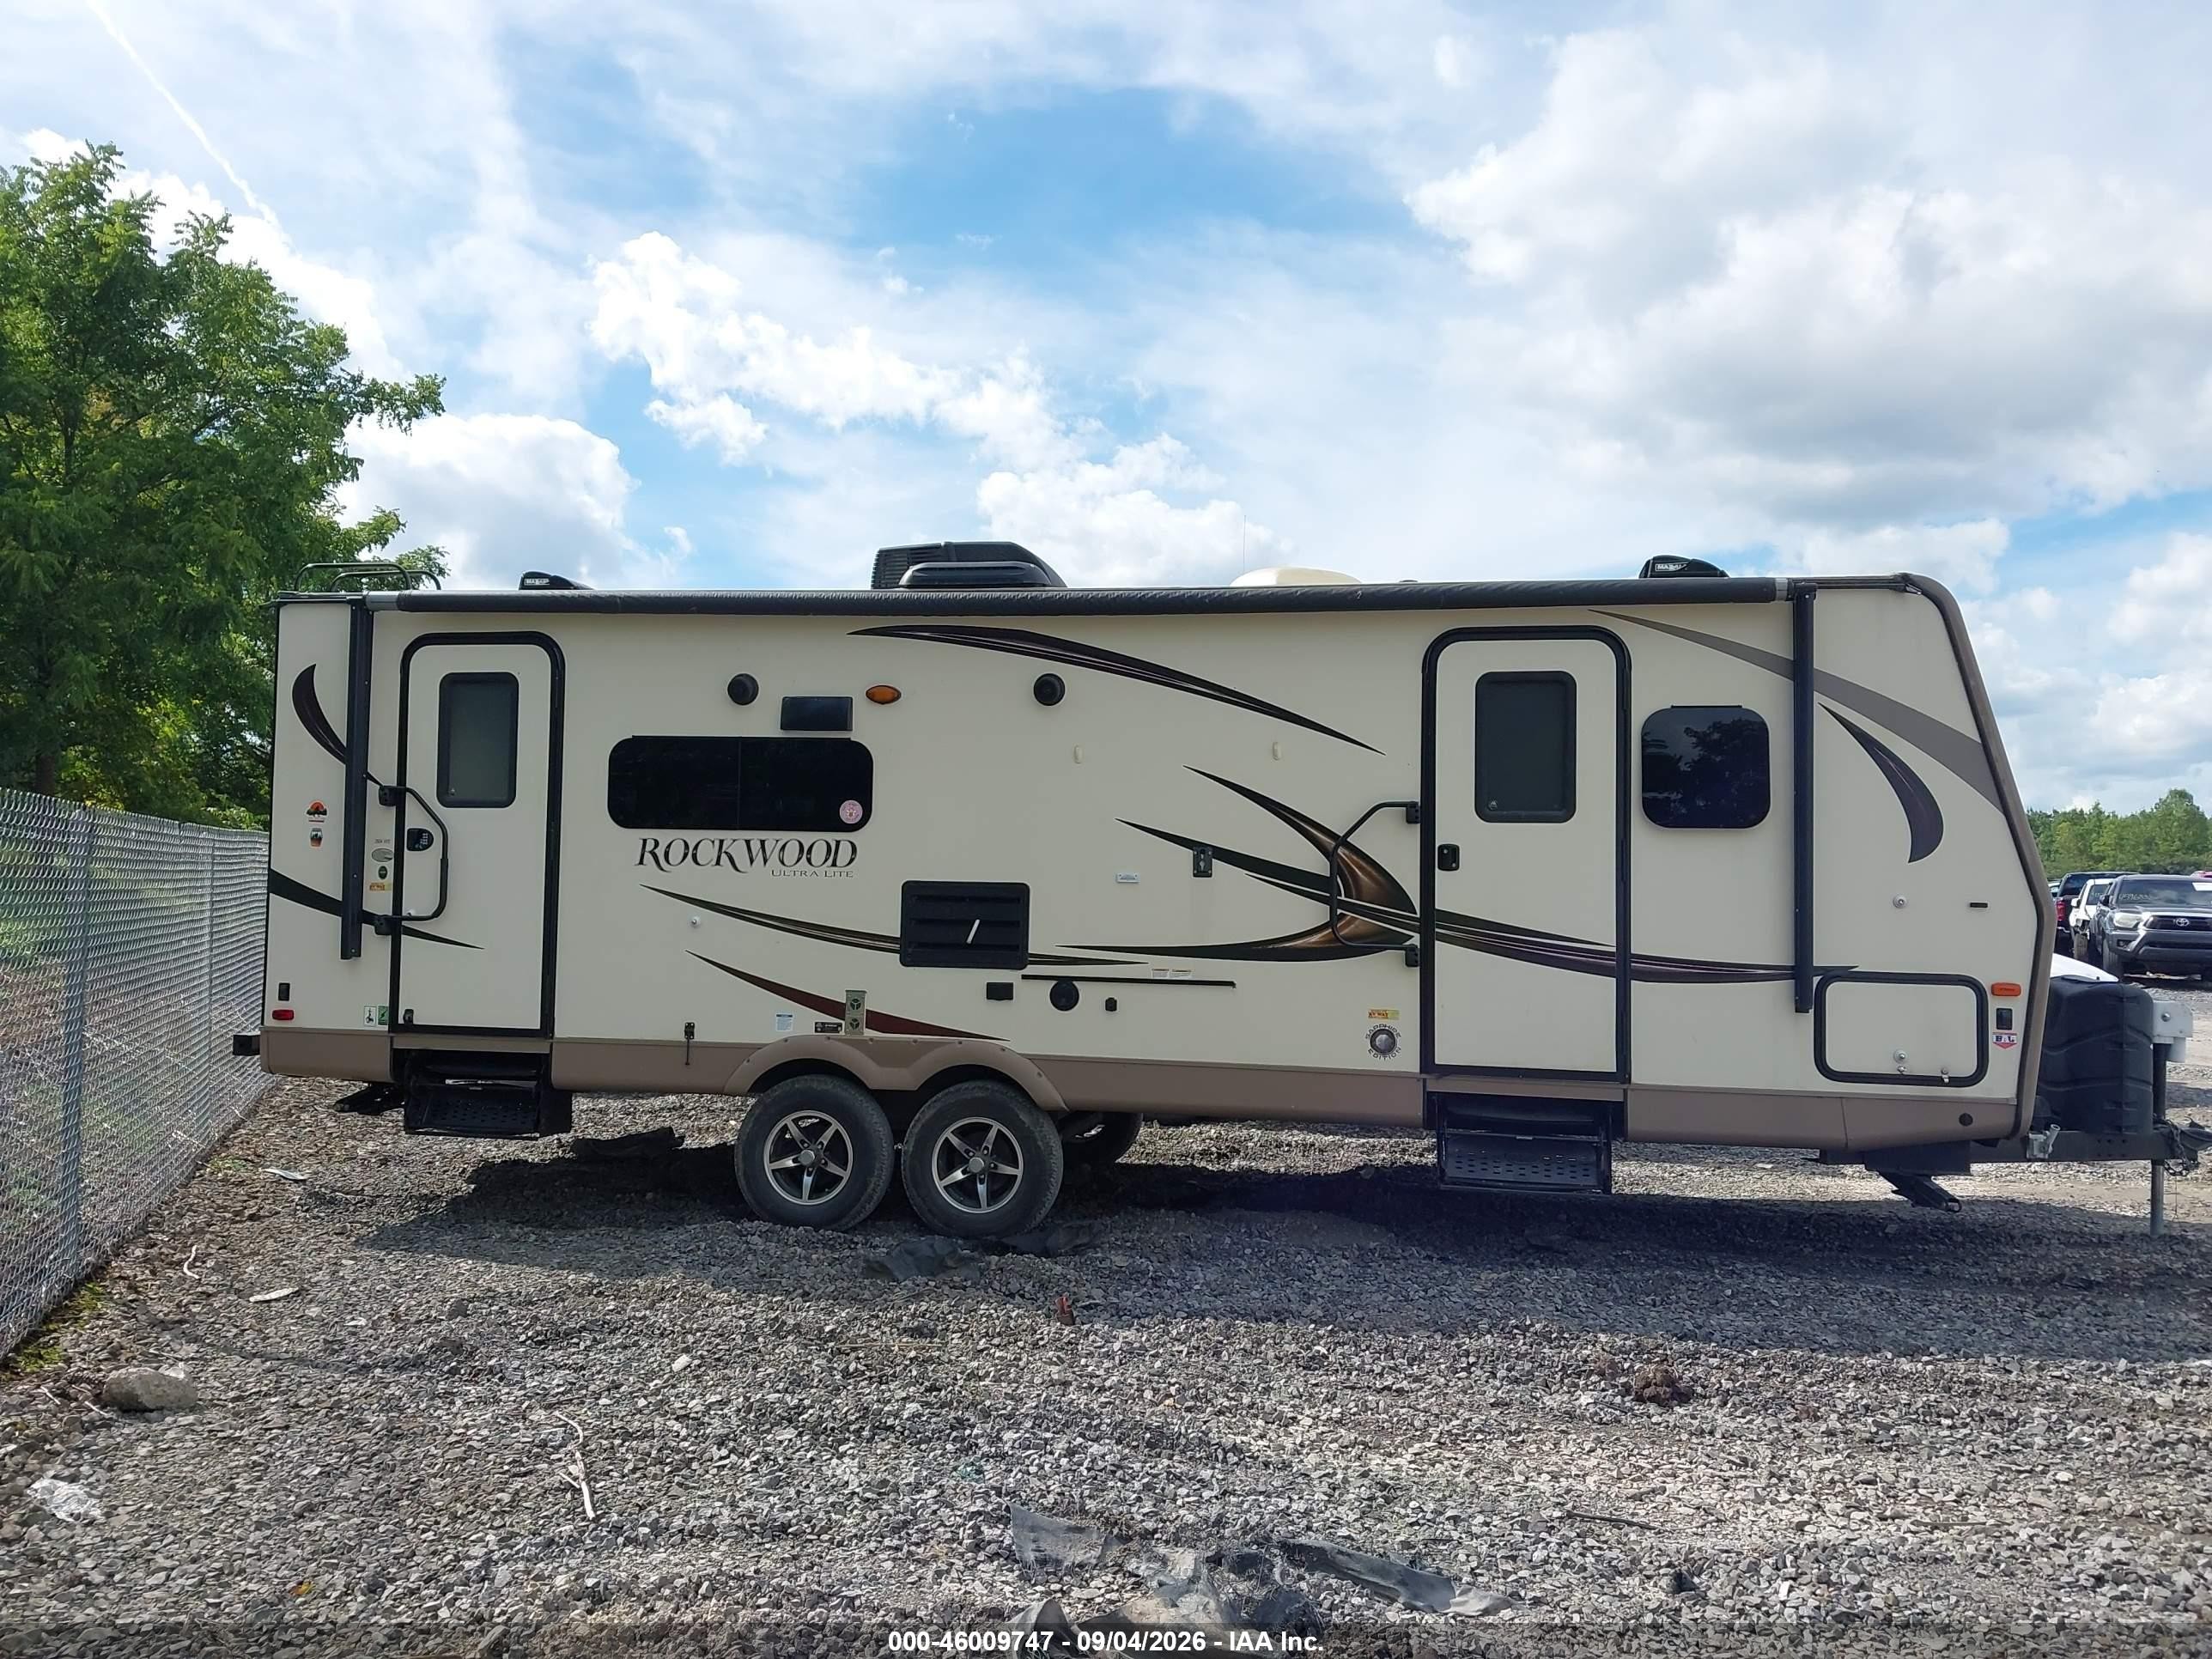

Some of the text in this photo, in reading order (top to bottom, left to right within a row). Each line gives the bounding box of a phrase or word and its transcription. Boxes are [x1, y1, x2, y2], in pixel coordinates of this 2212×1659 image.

[634, 837, 858, 873] ROCKWOOD
[771, 869, 818, 878] ULTRA
[1365, 1023, 1401, 1039] SAPPHIRE
[1367, 1047, 1401, 1061] EDITION
